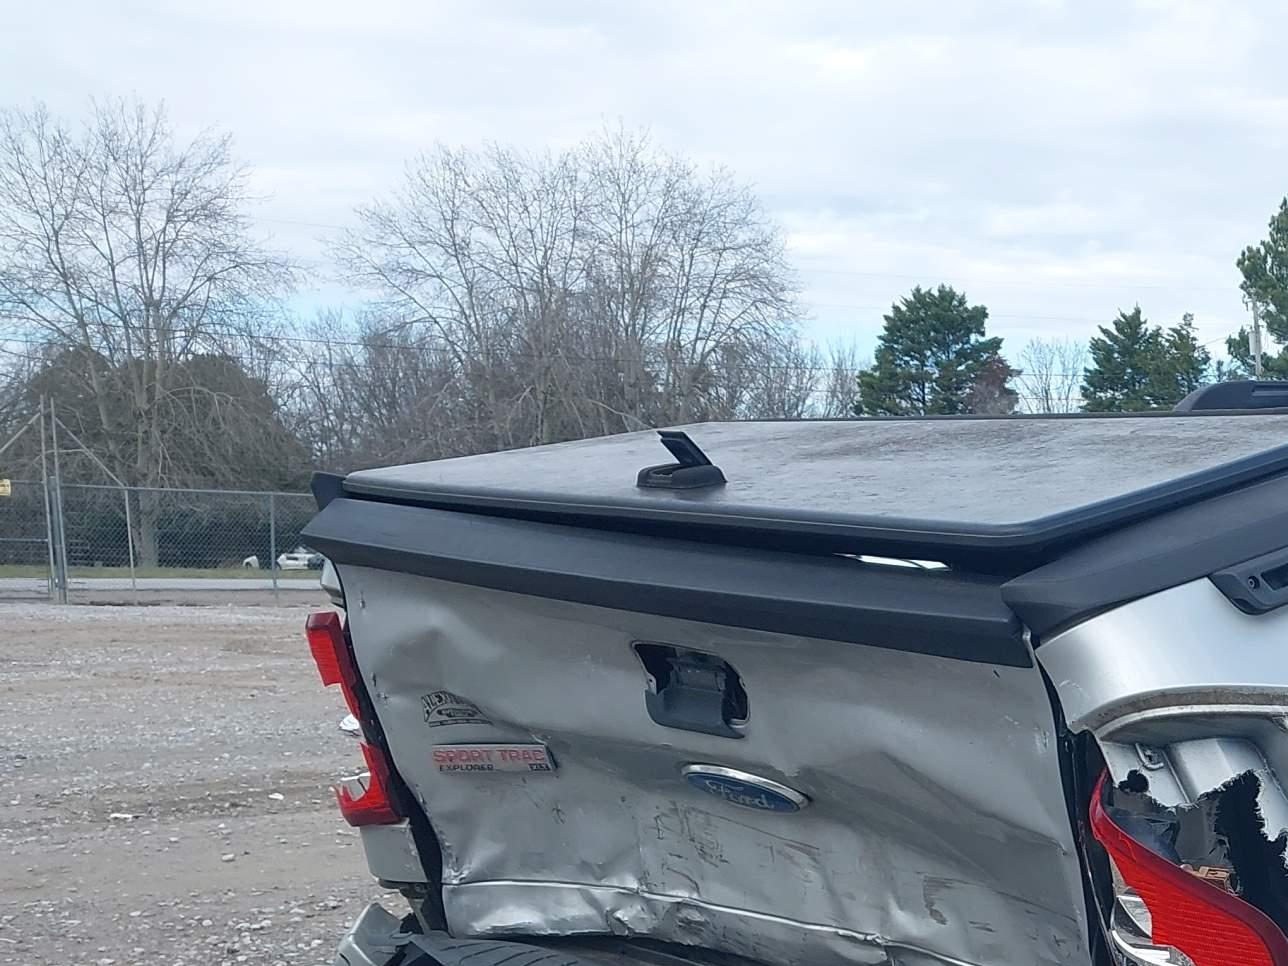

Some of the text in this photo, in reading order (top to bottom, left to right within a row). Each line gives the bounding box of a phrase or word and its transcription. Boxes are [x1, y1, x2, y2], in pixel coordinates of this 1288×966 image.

[433, 749, 545, 763] SPORT TRAC
[440, 763, 494, 772] EXPLORER
[705, 780, 775, 809] Ford
